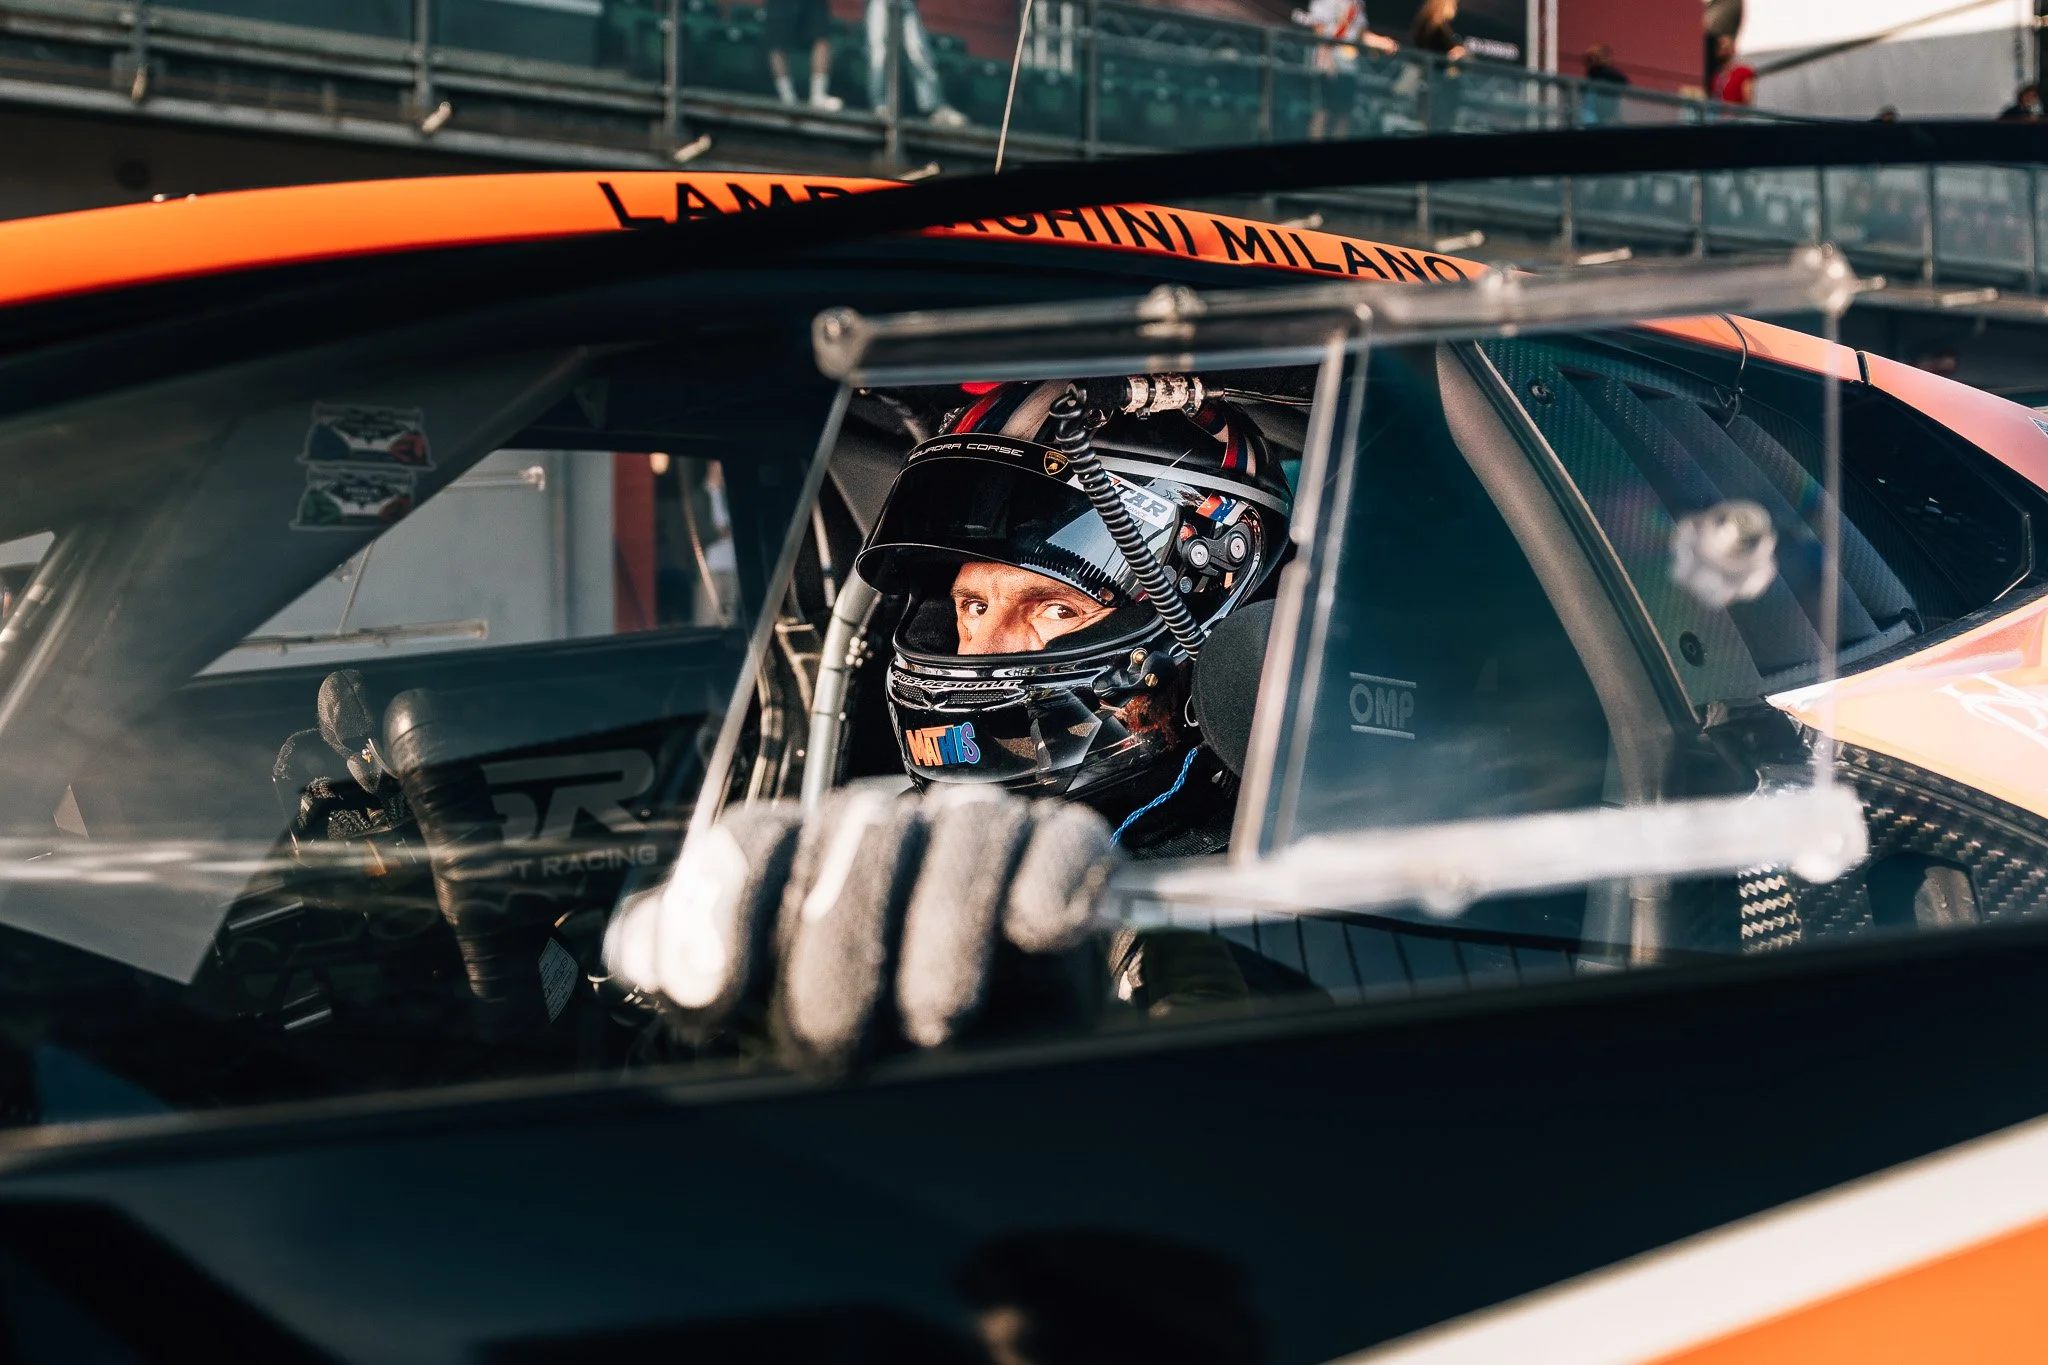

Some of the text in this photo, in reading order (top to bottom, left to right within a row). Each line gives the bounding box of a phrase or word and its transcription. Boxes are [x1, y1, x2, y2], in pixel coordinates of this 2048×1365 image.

[1211, 219, 1467, 283] MILANO
[966, 443, 1025, 457] CORSE
[1349, 683, 1415, 729] OMP
[906, 721, 981, 767] MATHIS
[541, 844, 658, 878] RACING
